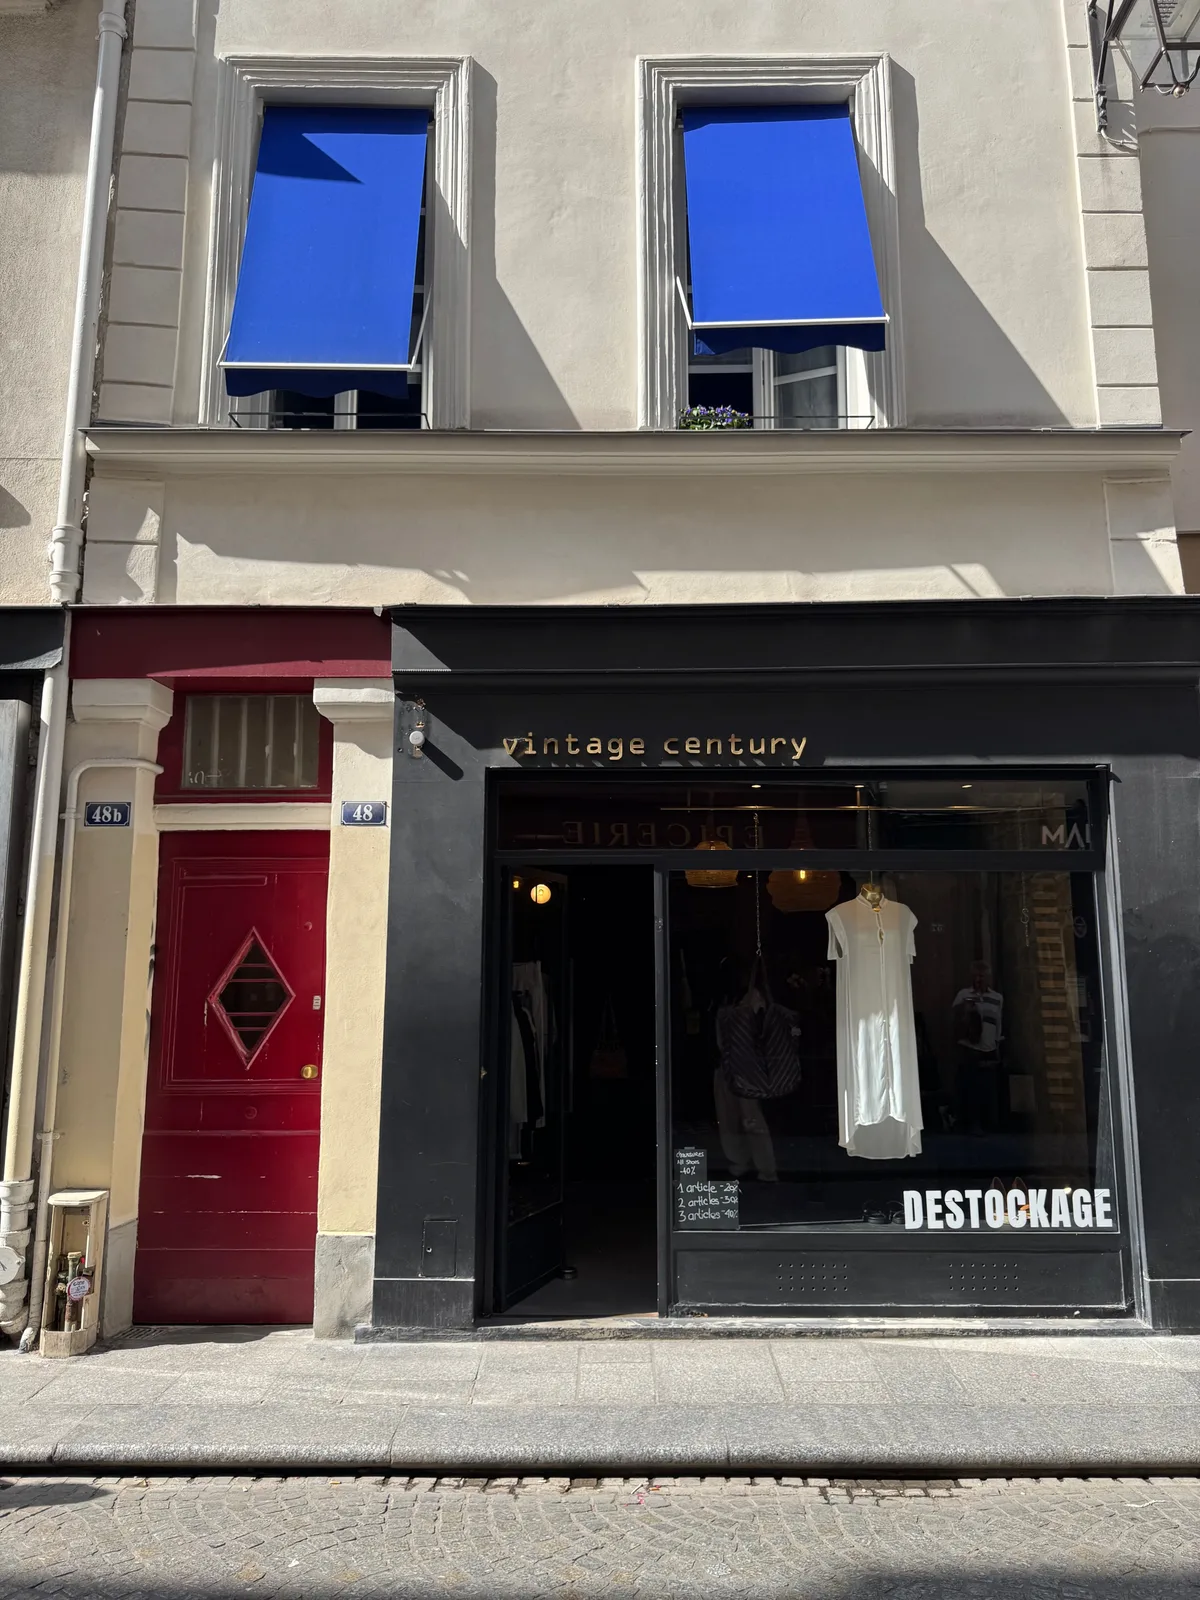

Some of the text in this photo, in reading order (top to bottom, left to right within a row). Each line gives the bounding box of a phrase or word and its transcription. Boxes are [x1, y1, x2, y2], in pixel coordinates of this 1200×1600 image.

[502, 732, 808, 761] vintage century
[91, 805, 122, 823] 48b
[352, 804, 373, 822] 48
[677, 1182, 685, 1194] 1
[686, 1180, 718, 1194] article
[677, 1197, 686, 1208] 2
[688, 1195, 719, 1207] articles
[902, 1188, 1113, 1230] DESTOCKAGE
[678, 1210, 687, 1223] 3
[688, 1208, 720, 1220] articles
